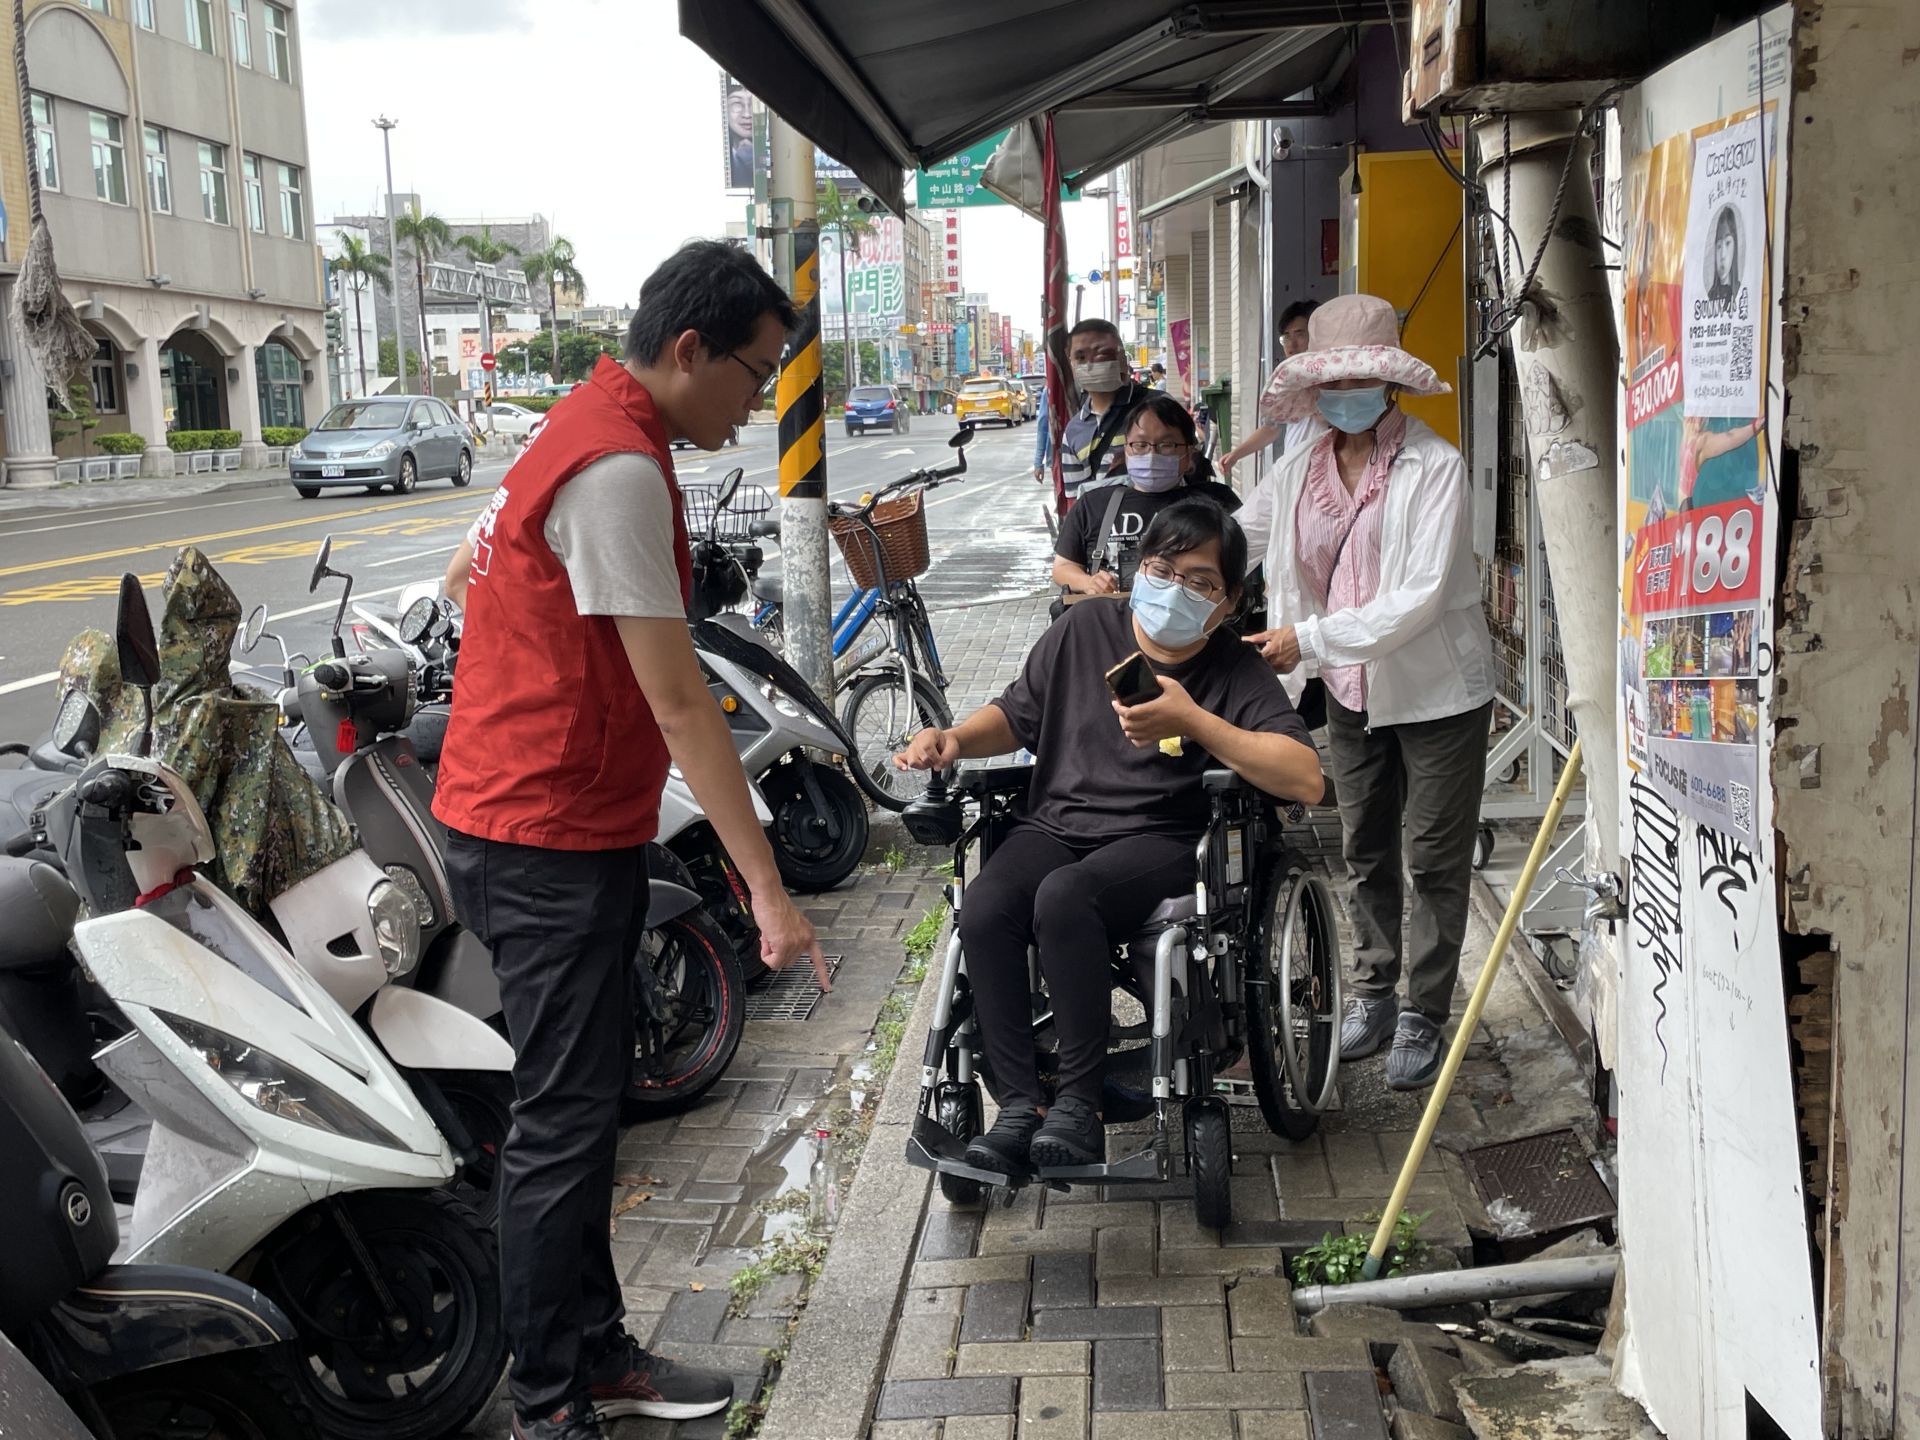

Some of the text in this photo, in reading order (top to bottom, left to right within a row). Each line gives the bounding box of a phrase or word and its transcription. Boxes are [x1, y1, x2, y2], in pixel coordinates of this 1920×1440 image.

[929, 183, 964, 195] 中山路
[847, 266, 904, 317] 門診
[1655, 753, 1687, 797] FOCUS店
[1691, 775, 1726, 803] 600-6688
